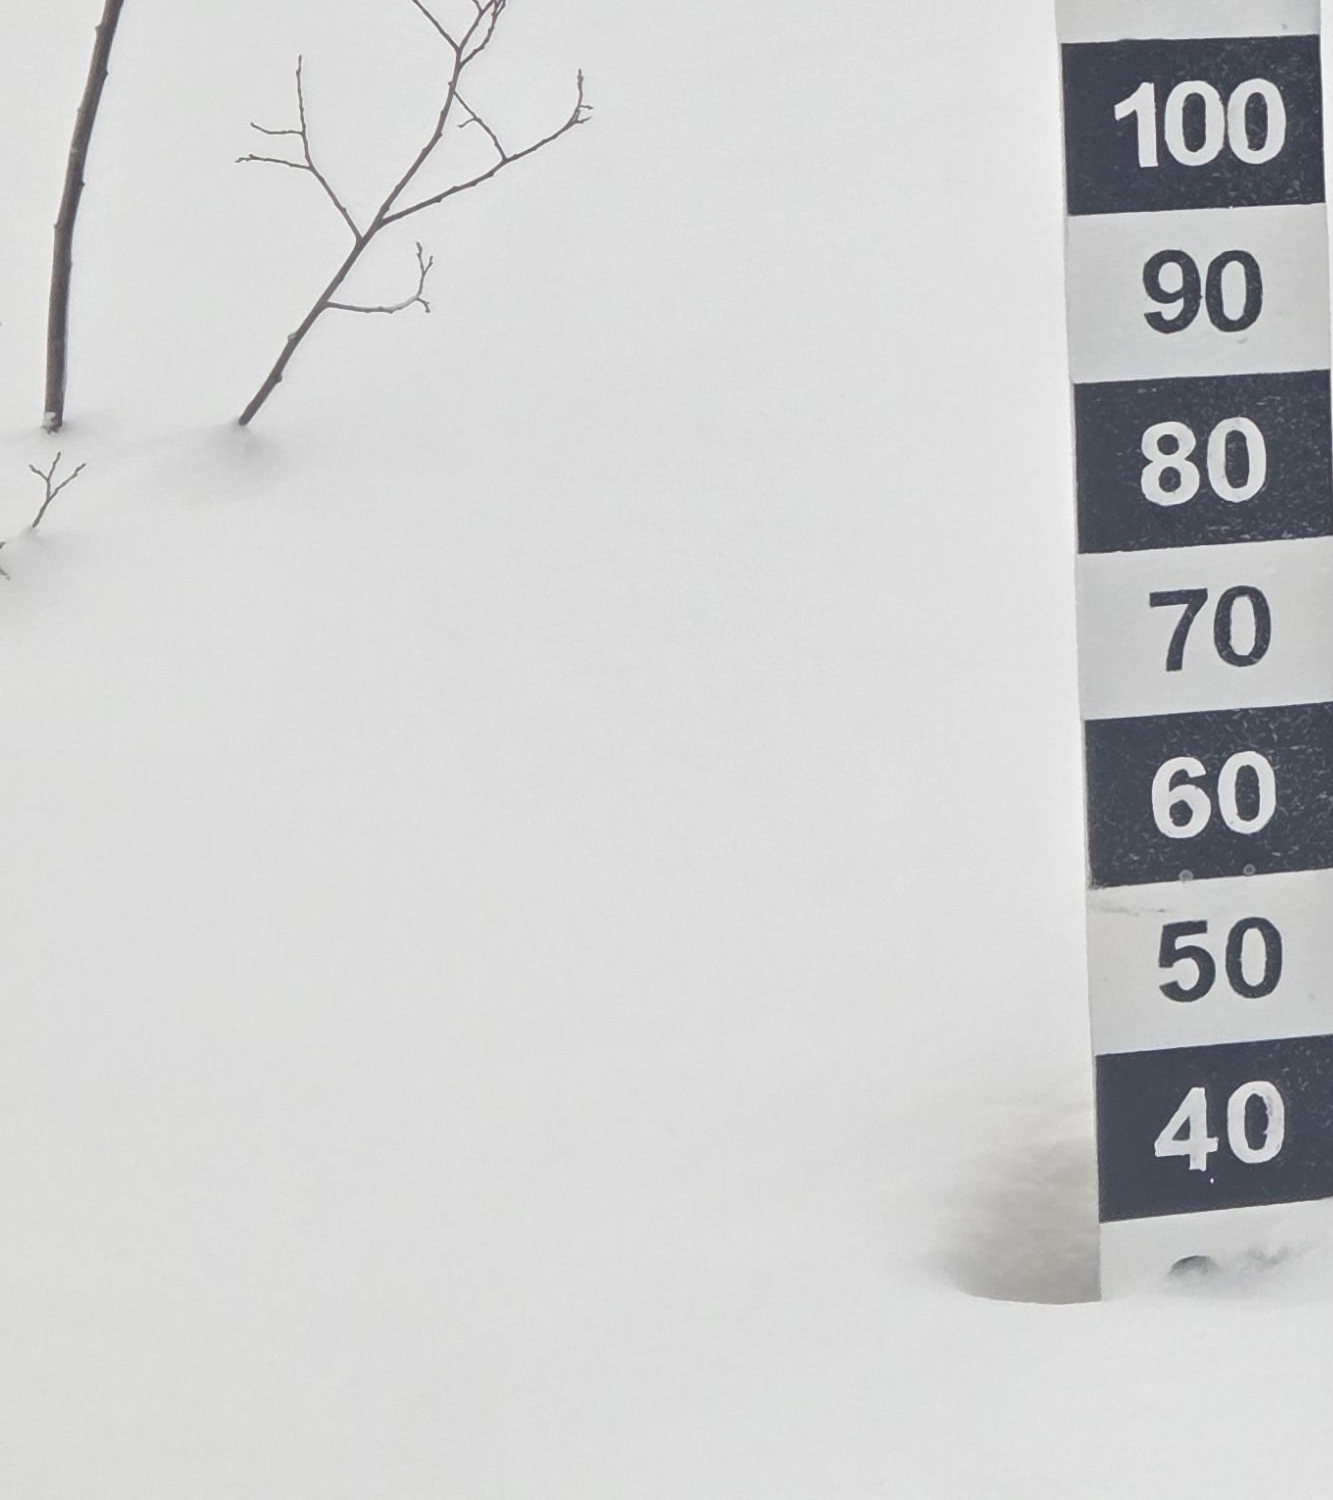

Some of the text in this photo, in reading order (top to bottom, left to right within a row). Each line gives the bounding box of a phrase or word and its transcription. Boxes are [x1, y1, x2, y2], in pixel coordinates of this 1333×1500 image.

[1112, 77, 1287, 168] 100
[1142, 249, 1264, 335] 90
[1140, 416, 1267, 507] 80
[1149, 584, 1273, 673] 70
[1151, 750, 1277, 839] 60
[1157, 916, 1284, 1003] 50
[1153, 1080, 1286, 1172] 40
